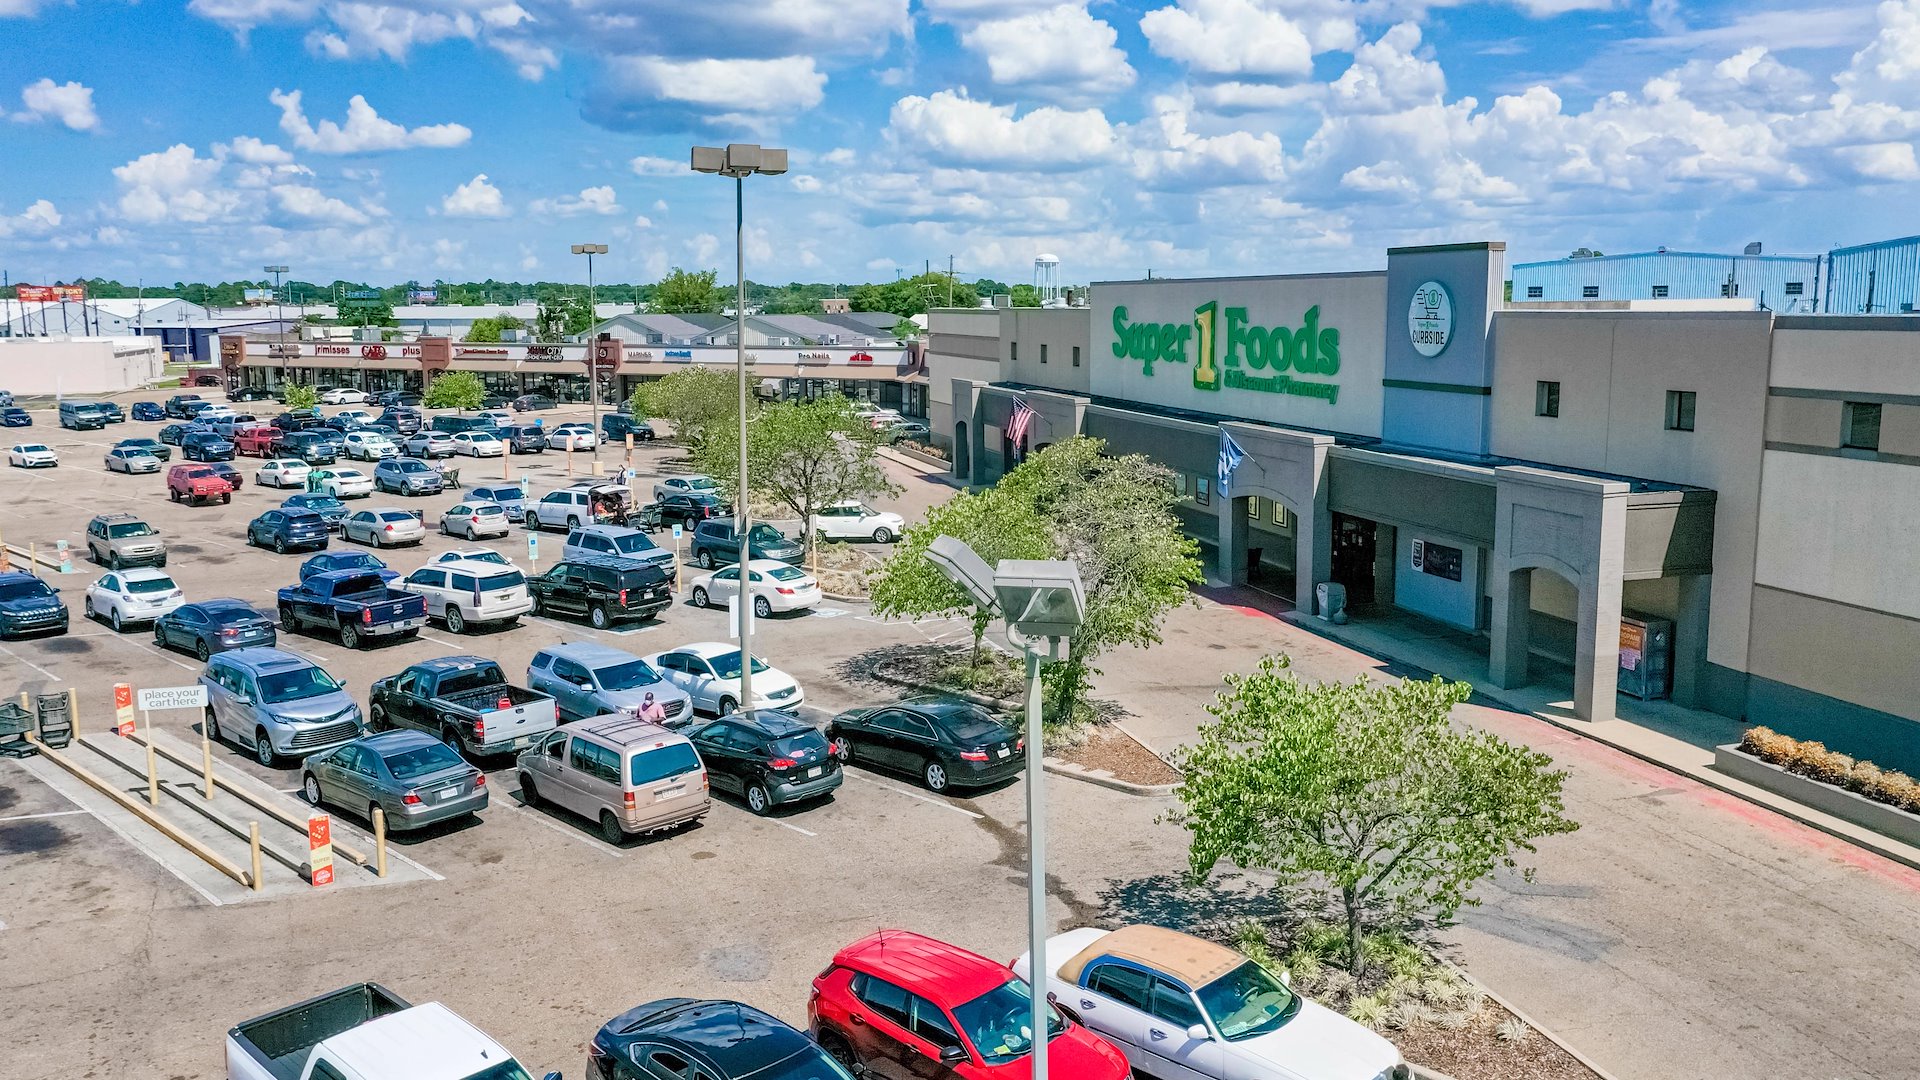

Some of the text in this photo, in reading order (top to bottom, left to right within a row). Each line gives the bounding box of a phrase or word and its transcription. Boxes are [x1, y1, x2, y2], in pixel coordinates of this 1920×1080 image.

[1413, 330, 1444, 345] CURBSIDE
[361, 345, 387, 360] CATO
[402, 346, 420, 357] plus
[1112, 300, 1340, 391] Super 1 Foods
[1279, 376, 1340, 404] Pharmacy
[145, 689, 200, 700] place your
[149, 697, 197, 708] cart here
